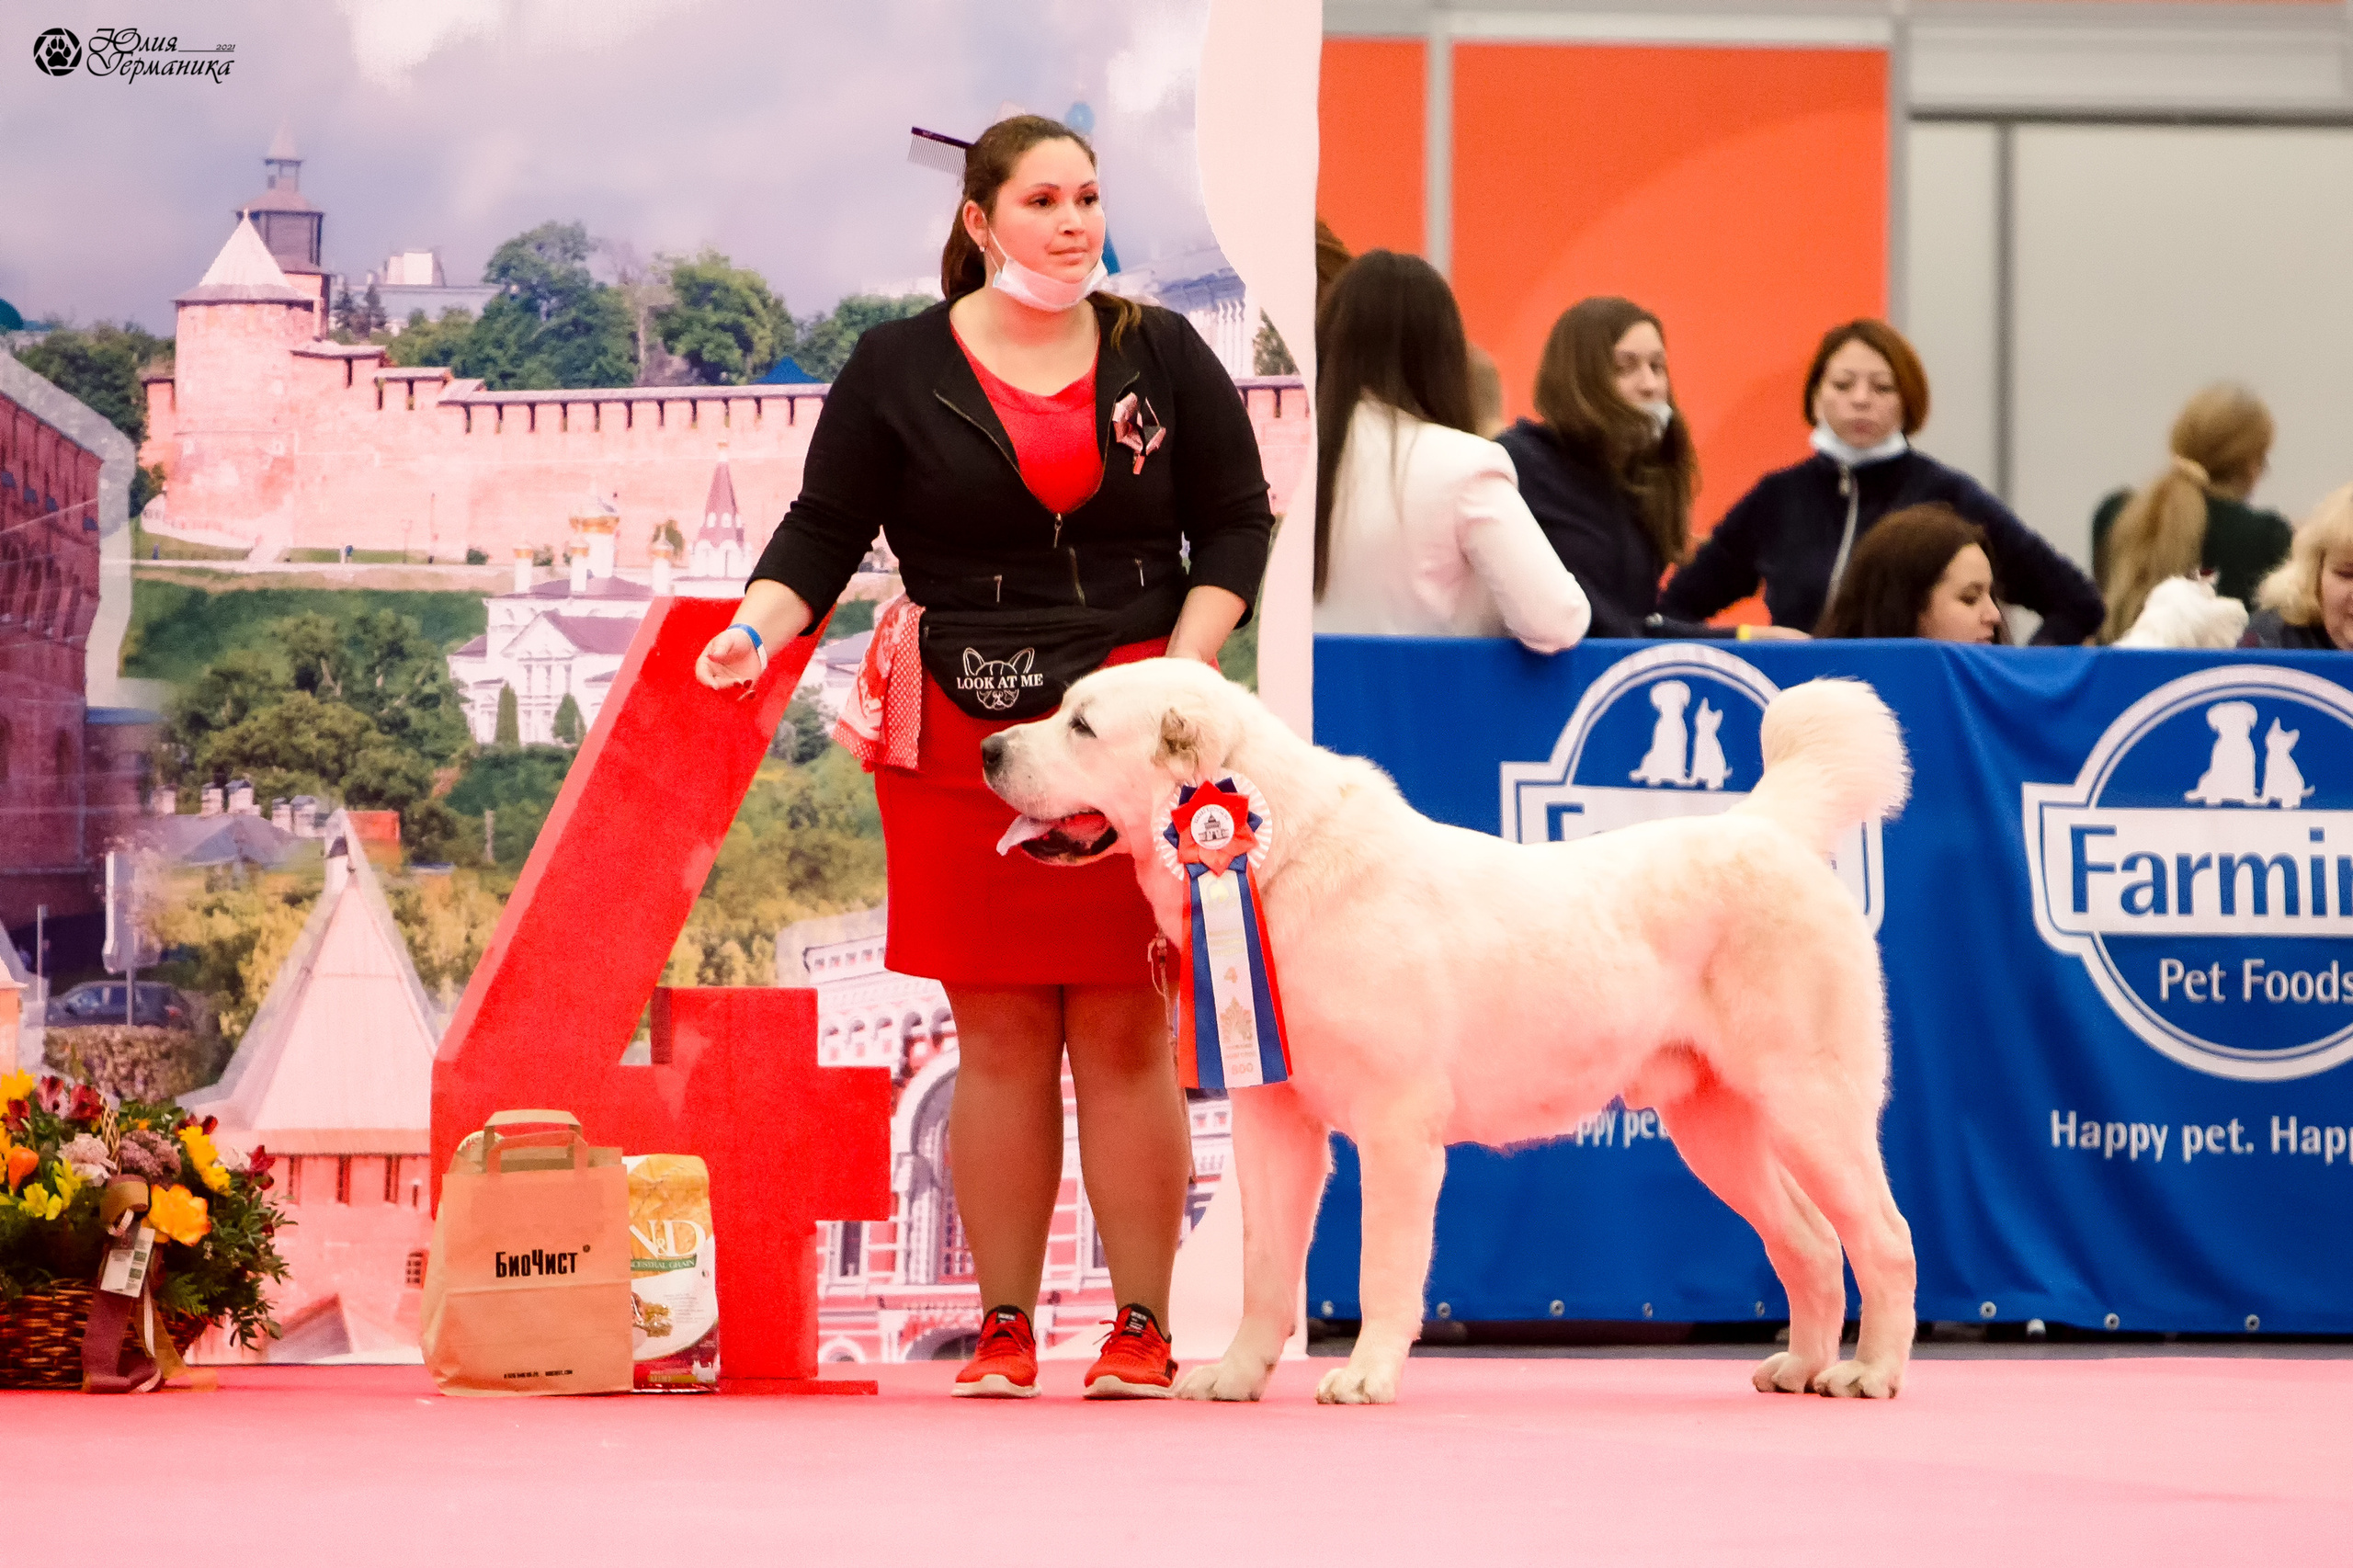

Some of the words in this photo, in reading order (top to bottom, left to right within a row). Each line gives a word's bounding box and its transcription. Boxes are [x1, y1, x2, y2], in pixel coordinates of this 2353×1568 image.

[957, 676, 995, 689] LOOK
[997, 676, 1017, 689] AT
[1021, 674, 1044, 687] ME
[430, 596, 892, 1381] 4
[1224, 967, 1238, 983] 4
[2160, 958, 2226, 1004] Pet
[1576, 1110, 1617, 1147] ppy
[2050, 1109, 2169, 1163] Happy
[2181, 1117, 2255, 1165] pet.
[495, 1249, 578, 1278] БиоЧист
